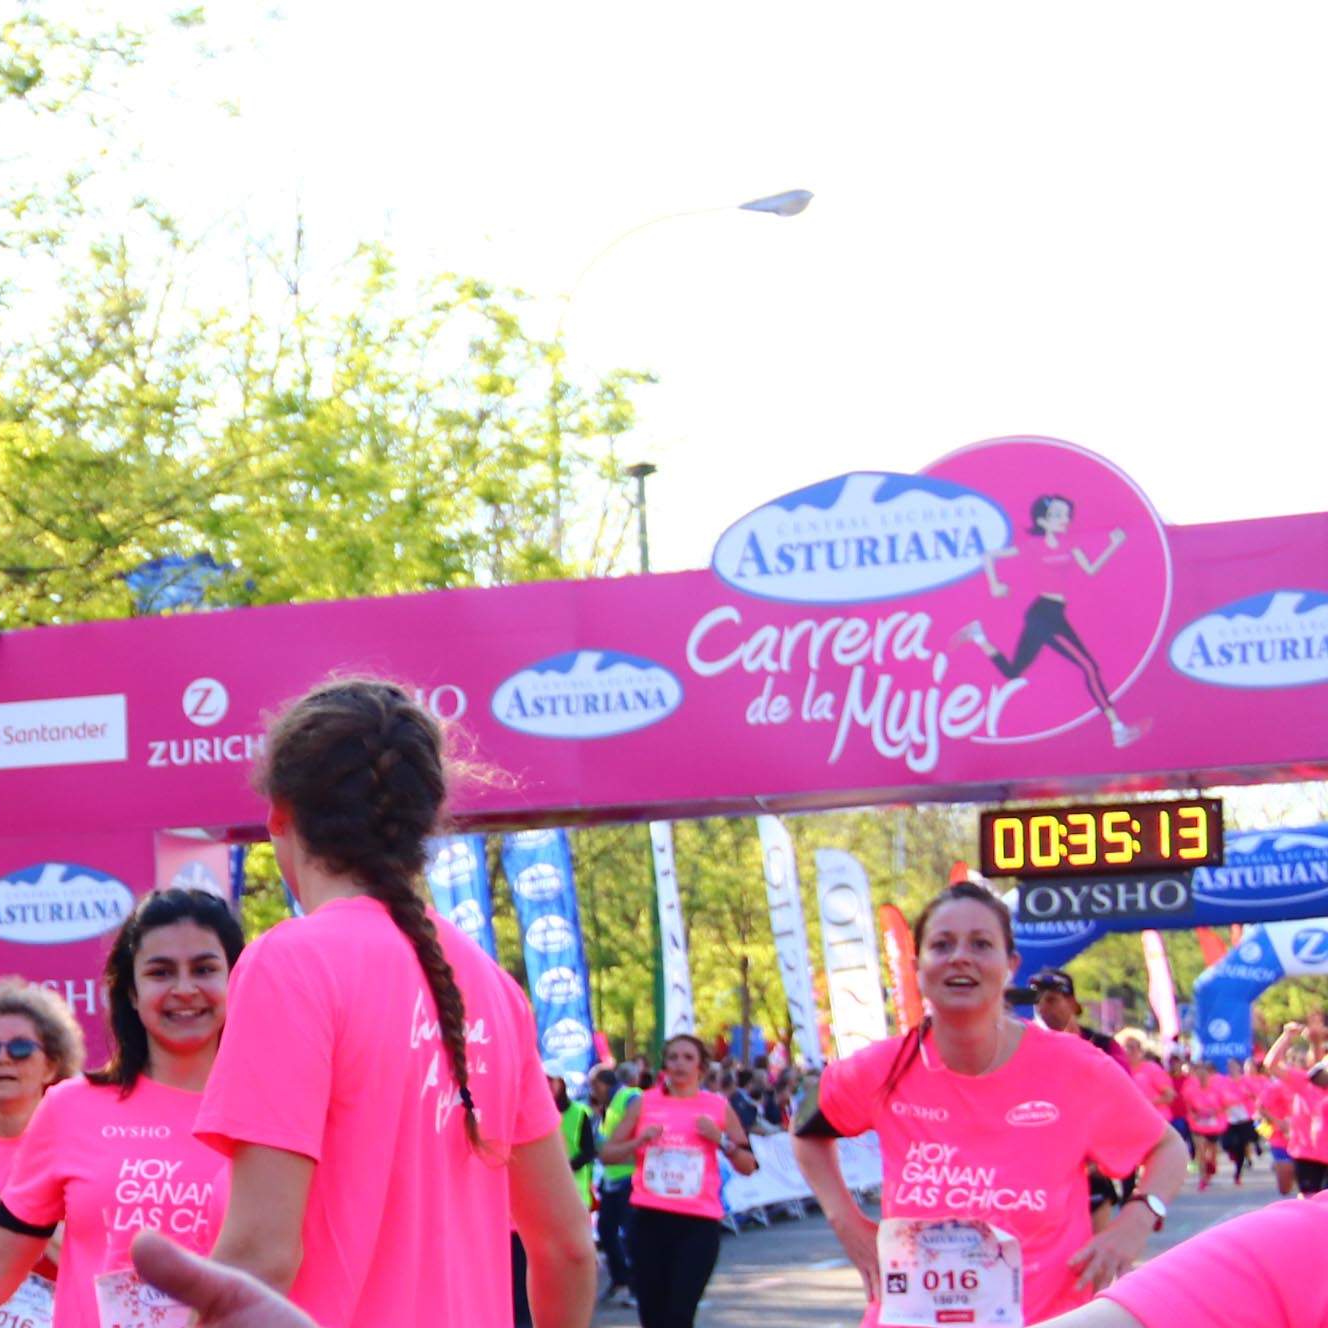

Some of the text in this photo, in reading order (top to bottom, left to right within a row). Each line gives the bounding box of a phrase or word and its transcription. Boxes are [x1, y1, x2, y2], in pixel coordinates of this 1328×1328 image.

[734, 525, 988, 579] ASTURIANA
[686, 605, 932, 677] Carrera
[506, 686, 668, 719] ASTURIANA
[745, 652, 1029, 774] de la Mujer
[3, 722, 108, 746] Santander
[1025, 879, 1187, 917] OYSHO
[101, 1125, 172, 1139] OYSHO
[906, 1141, 959, 1164] HOY
[119, 1158, 183, 1180] HOY
[902, 1162, 995, 1187] GANAN
[896, 1183, 1046, 1211] LAS CHICAS
[113, 1207, 164, 1231] LAS
[923, 1269, 979, 1291] 016
